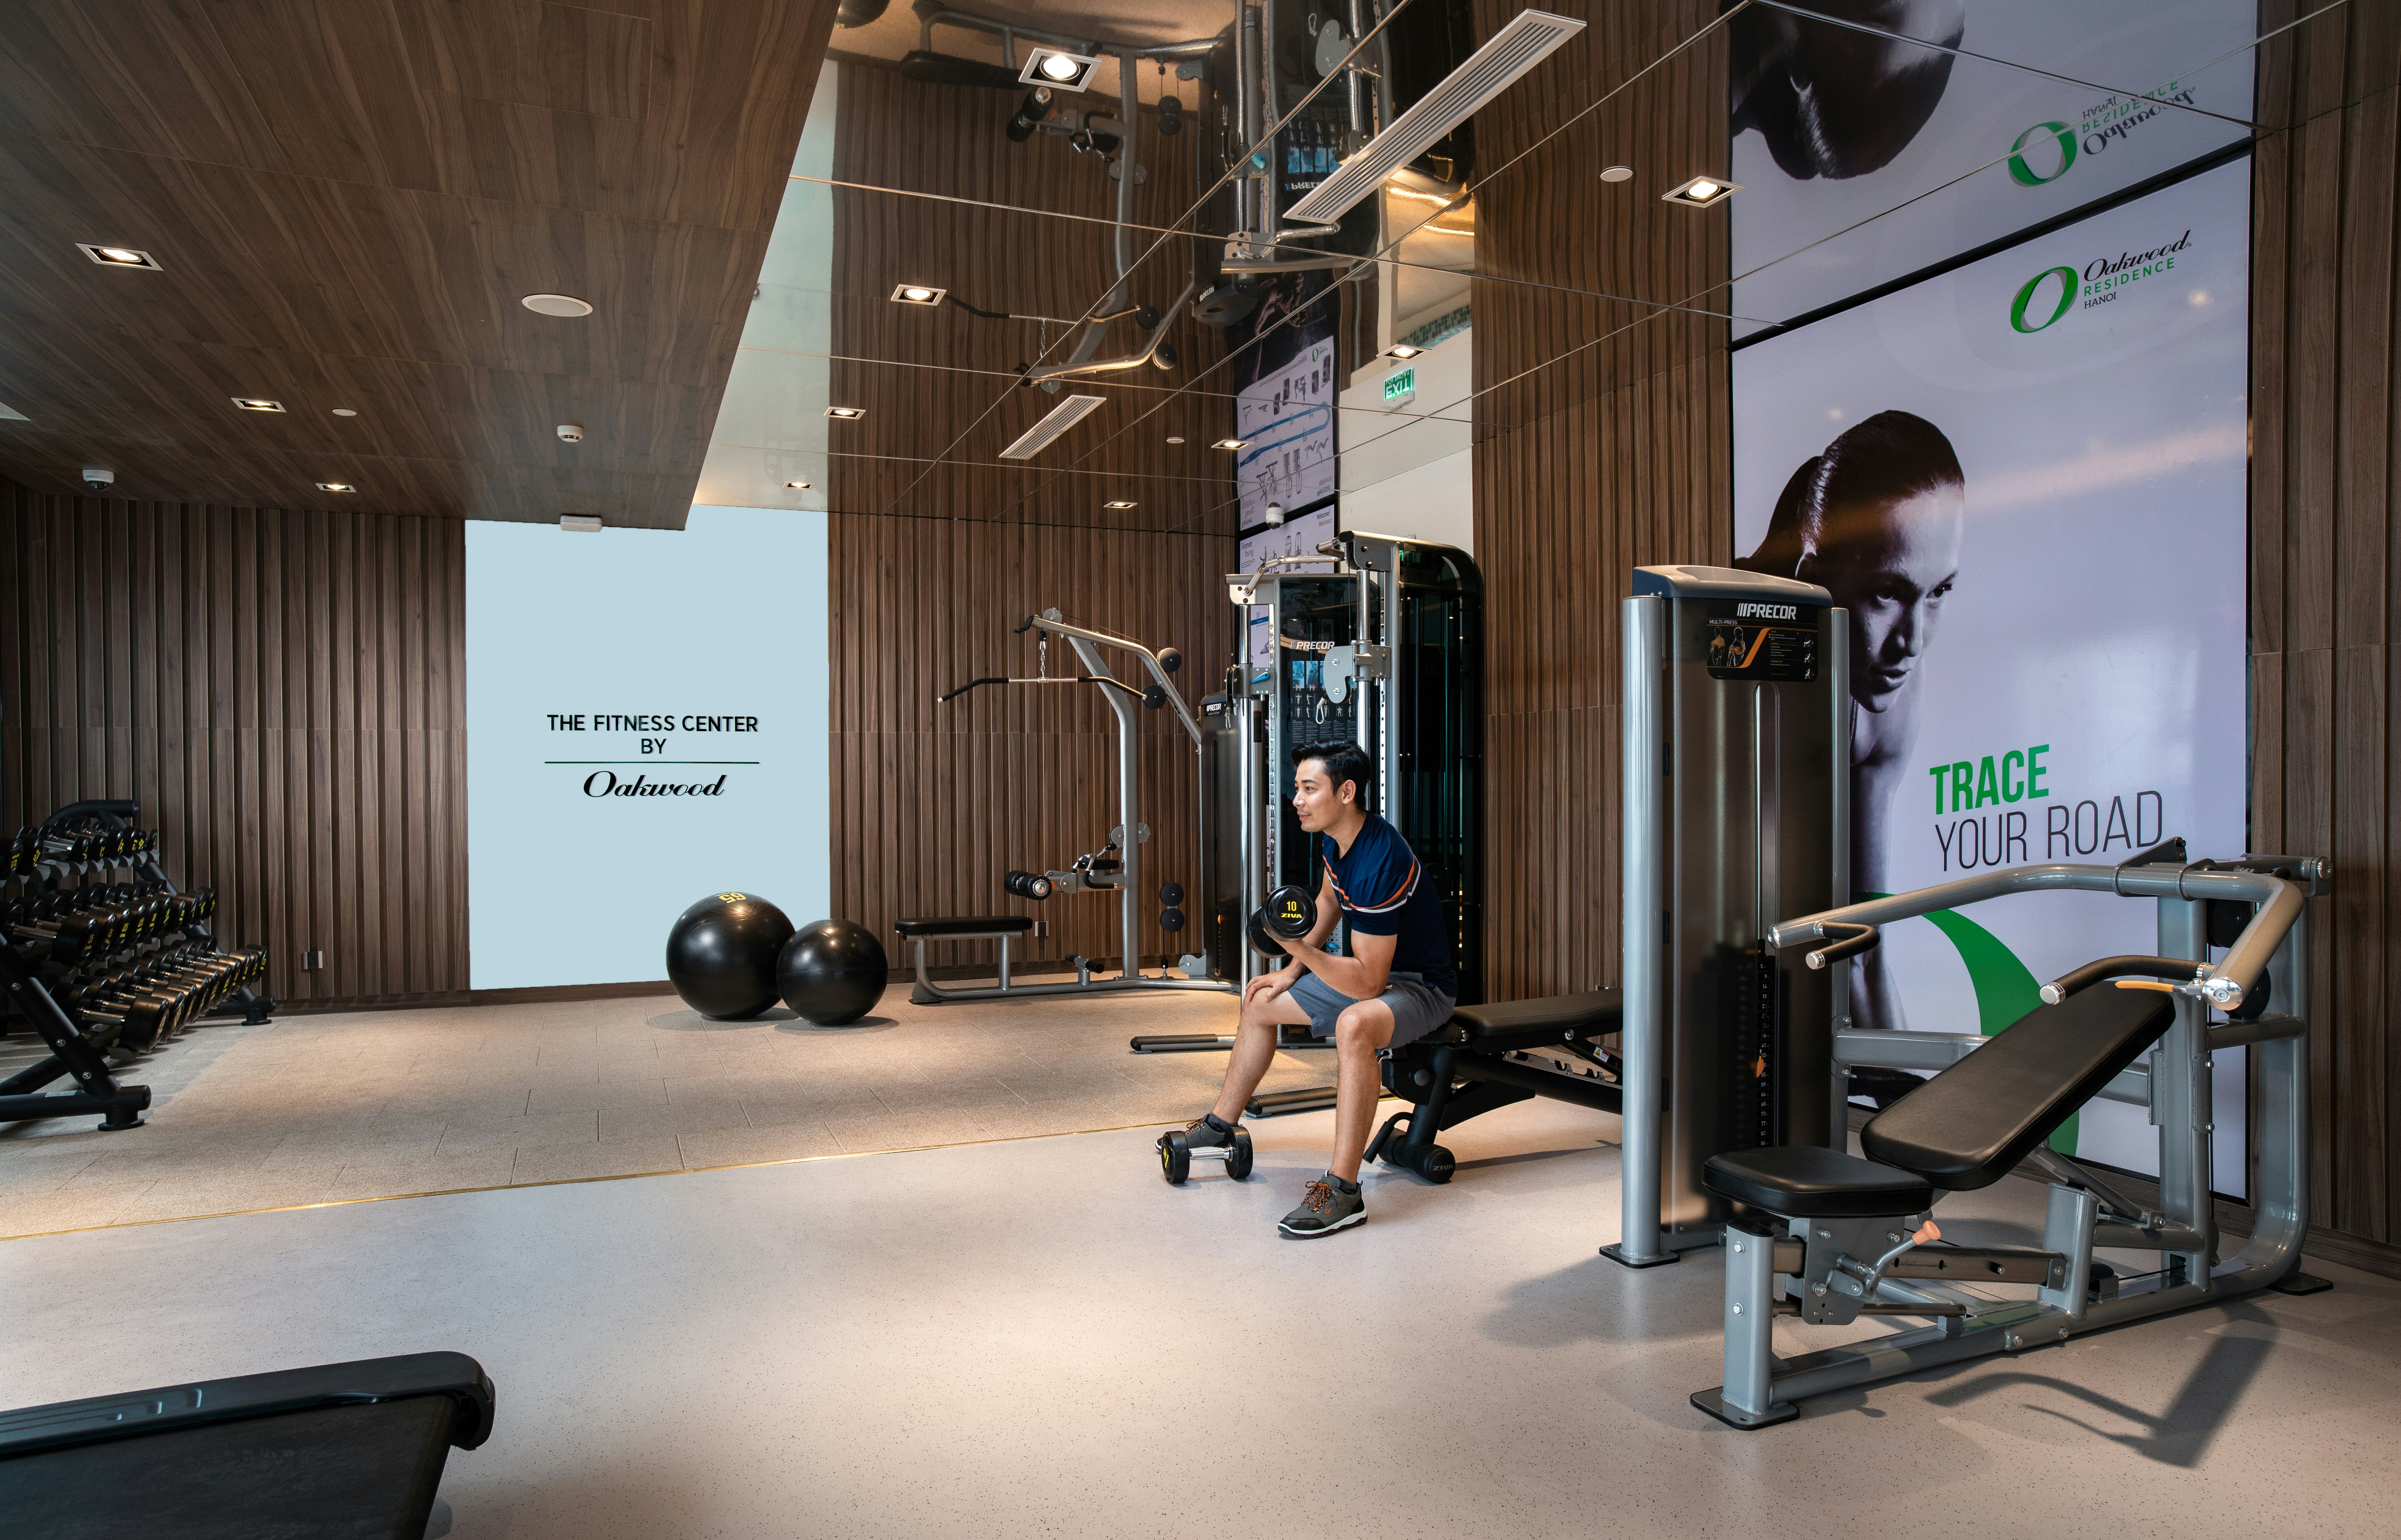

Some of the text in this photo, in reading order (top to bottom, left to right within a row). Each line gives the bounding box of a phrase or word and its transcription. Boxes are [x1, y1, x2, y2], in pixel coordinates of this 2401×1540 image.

[2084, 258, 2174, 296] RESIDENCE
[2084, 292, 2116, 309] HANOI
[1317, 510, 1330, 520] Welcome!
[1319, 517, 1332, 527] Wellness!
[1241, 541, 1252, 550] Forever
[1746, 603, 1796, 620] PRECOR
[1296, 641, 1335, 649] PRECOR
[547, 715, 758, 732] THE FITNESS CENTER
[641, 738, 666, 754] BY
[583, 771, 726, 797] Oakwood
[1930, 744, 2049, 815] TRACE
[1935, 791, 2162, 872] YOUR ROAD
[719, 893, 746, 903] 65
[1287, 901, 1297, 911] 10
